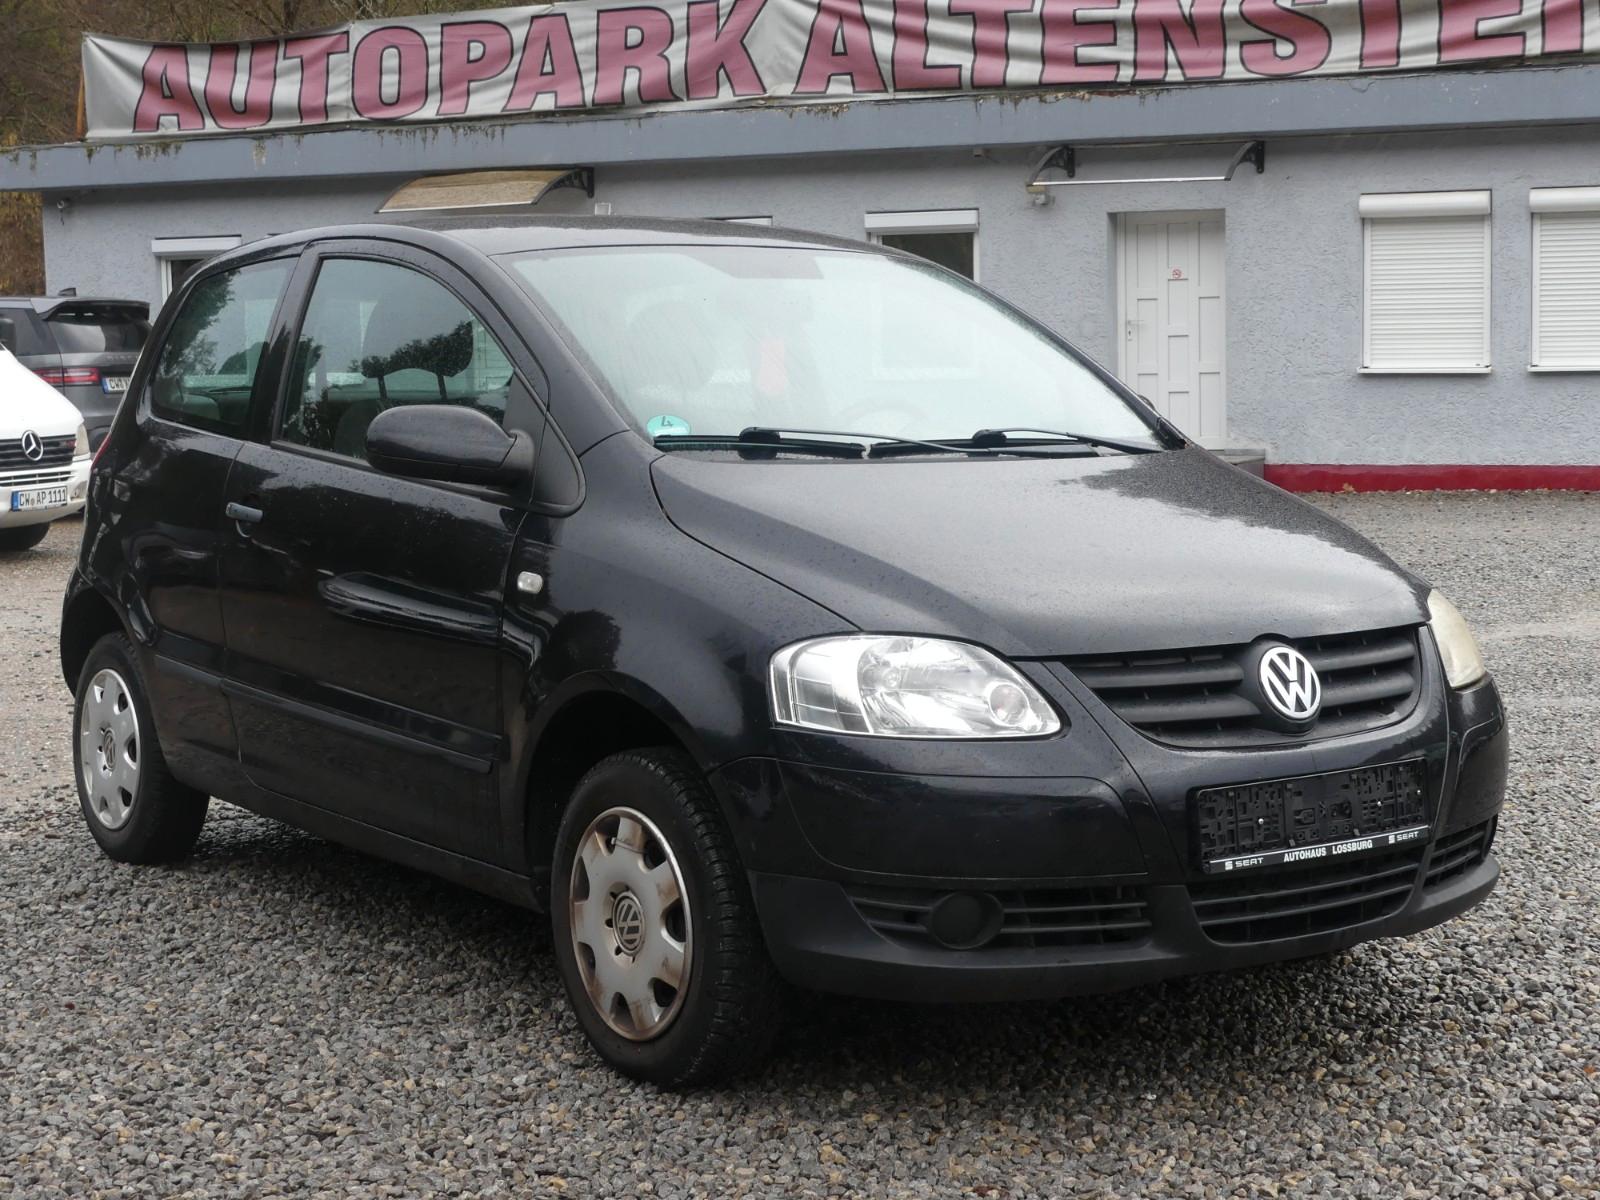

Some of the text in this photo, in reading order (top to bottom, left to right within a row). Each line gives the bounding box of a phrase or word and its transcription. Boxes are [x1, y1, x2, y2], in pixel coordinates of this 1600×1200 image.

[132, 0, 766, 133] AUTOPARK
[20, 489, 66, 506] CW AP 1111
[1262, 648, 1319, 718] VW
[1235, 831, 1419, 868] SEAT AUTOHAUS LOSSBURG SEAT
